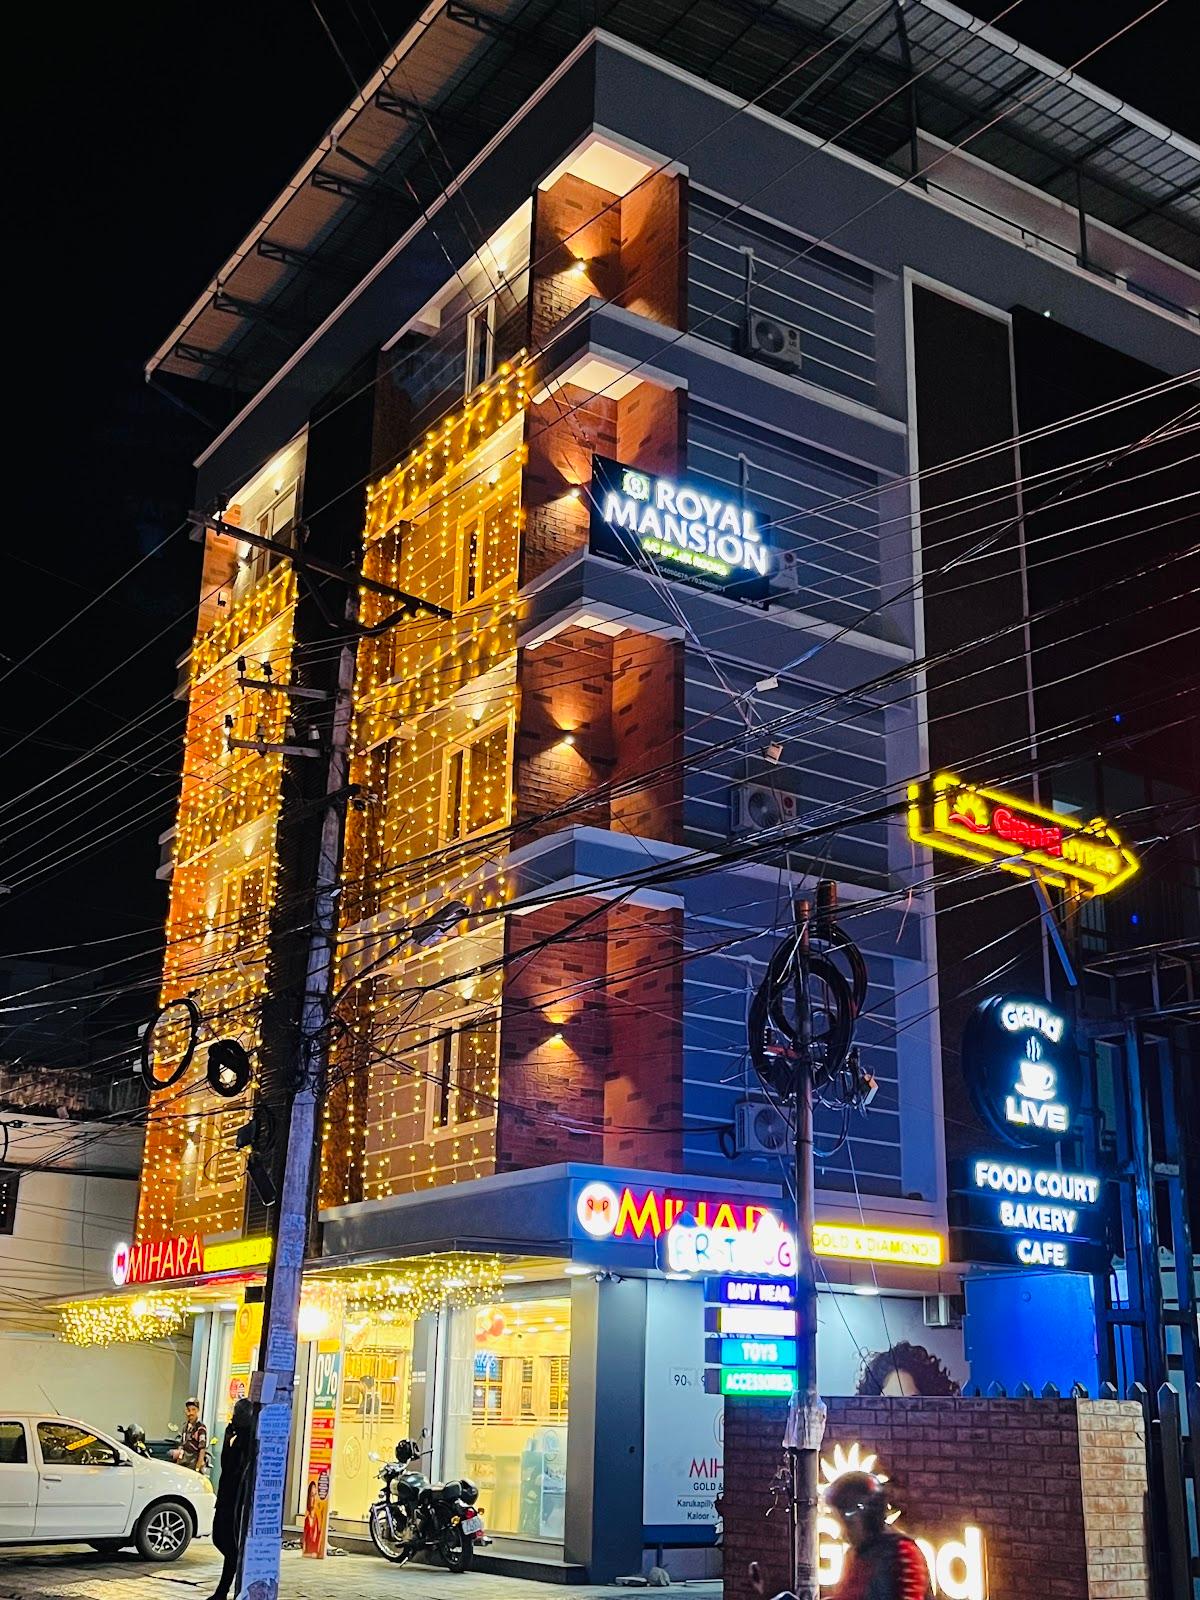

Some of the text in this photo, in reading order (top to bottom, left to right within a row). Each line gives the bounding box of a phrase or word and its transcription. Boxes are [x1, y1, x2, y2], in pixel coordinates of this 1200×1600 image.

[656, 481, 760, 543] ROYAL
[604, 494, 768, 577] MANSION
[1001, 1004, 1063, 1043] Grand
[1006, 1096, 1067, 1131] LIVE
[975, 1162, 1099, 1203] FOOD COURT
[1000, 1202, 1076, 1233] BAKERY
[813, 1232, 850, 1249] GOLD
[1017, 1239, 1066, 1266] CAFE
[126, 1234, 202, 1284] MIHARA
[693, 1482, 715, 1491] GOLD
[687, 1511, 709, 1521] Kaloor
